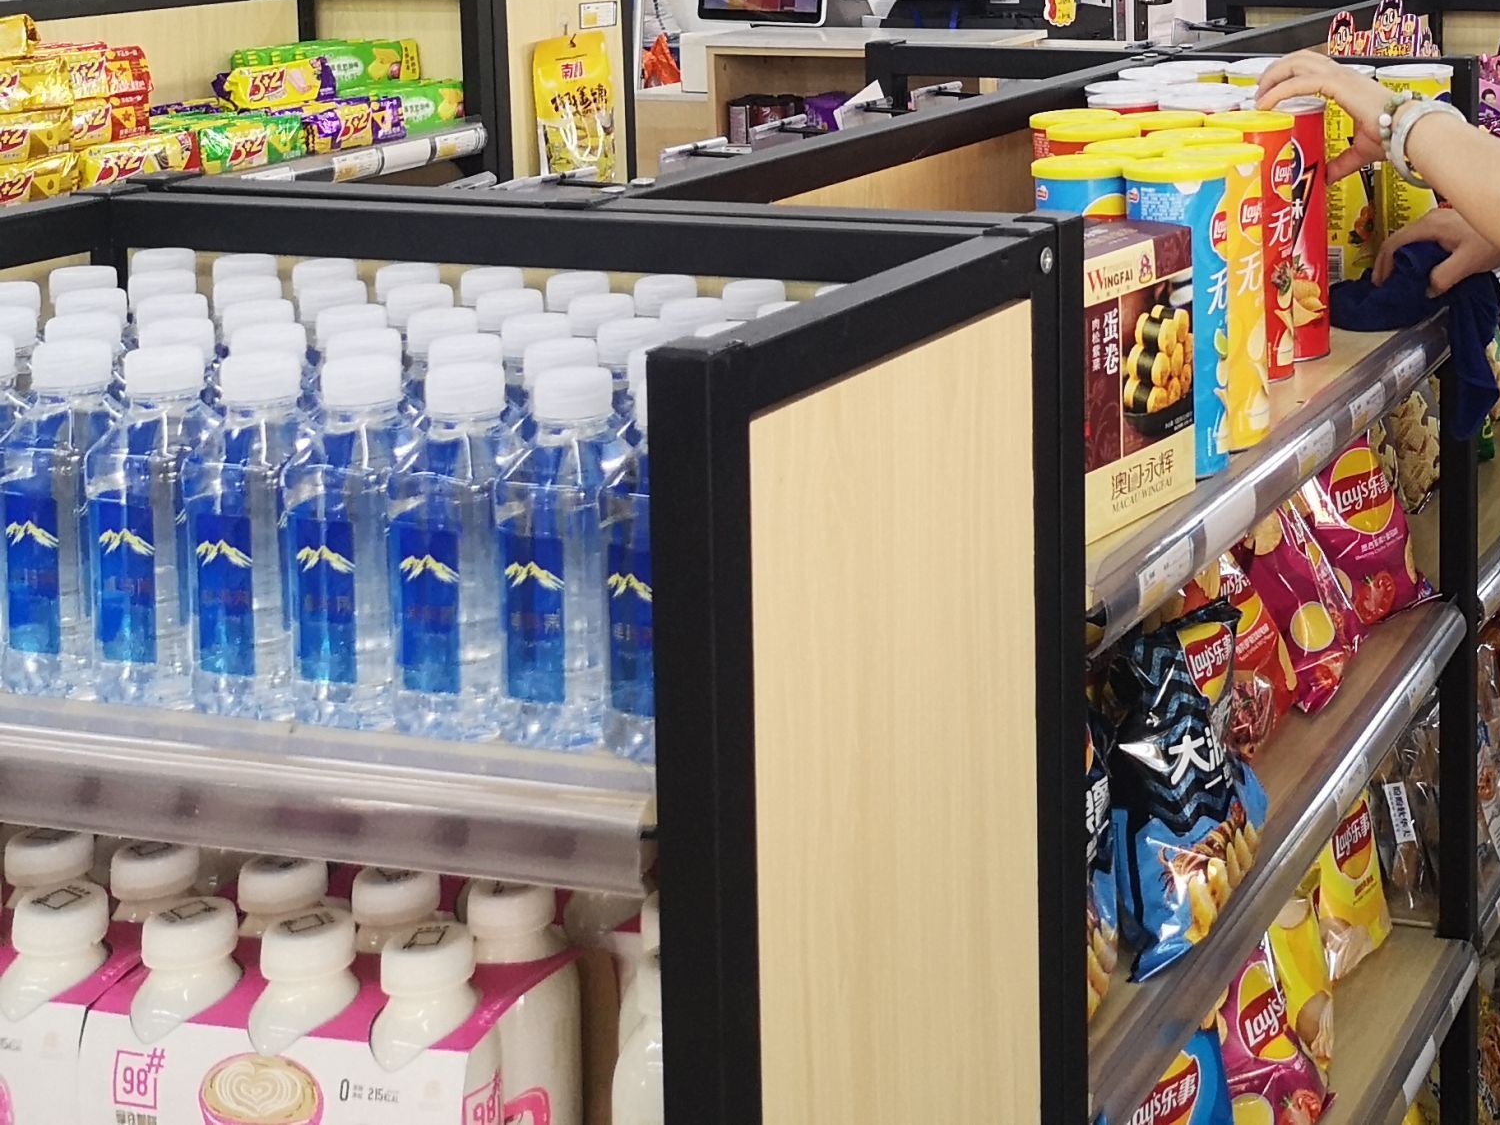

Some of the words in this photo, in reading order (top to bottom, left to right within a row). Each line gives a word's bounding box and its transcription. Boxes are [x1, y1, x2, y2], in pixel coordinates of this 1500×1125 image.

[250, 69, 286, 101] 3+2
[338, 110, 371, 140] 3+2
[229, 135, 267, 165] 3+2
[1087, 266, 1134, 293] WINGFAI
[1103, 307, 1119, 375] 蛋卷
[1111, 447, 1175, 501] 澳门永辉
[1160, 1072, 1197, 1117] 乐事
